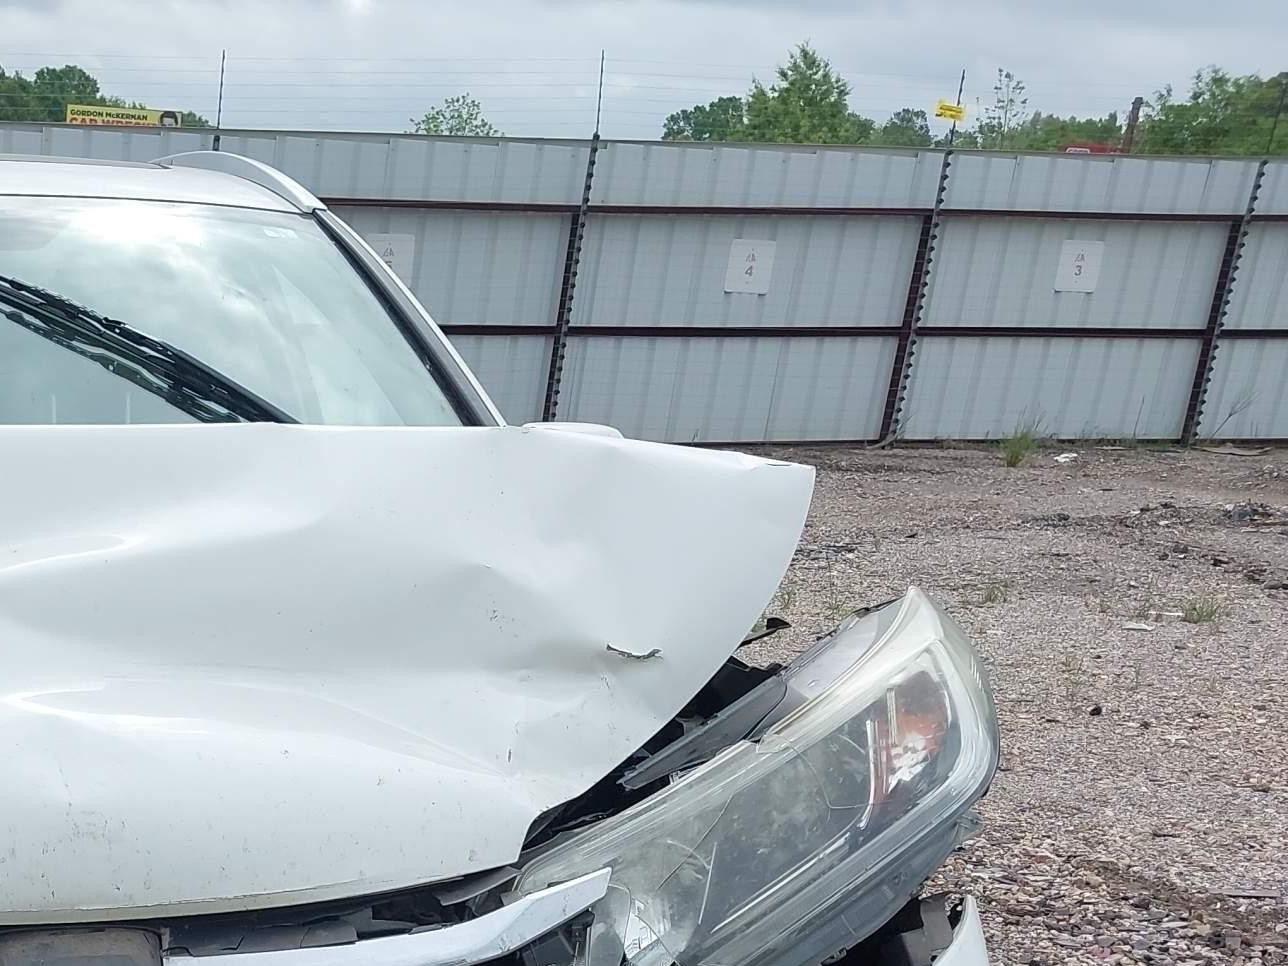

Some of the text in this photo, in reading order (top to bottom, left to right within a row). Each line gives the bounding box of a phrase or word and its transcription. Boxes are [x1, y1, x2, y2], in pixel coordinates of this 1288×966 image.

[70, 109, 148, 121] GORDON McKERNAN
[744, 265, 753, 277] 4
[1074, 265, 1082, 276] 3
